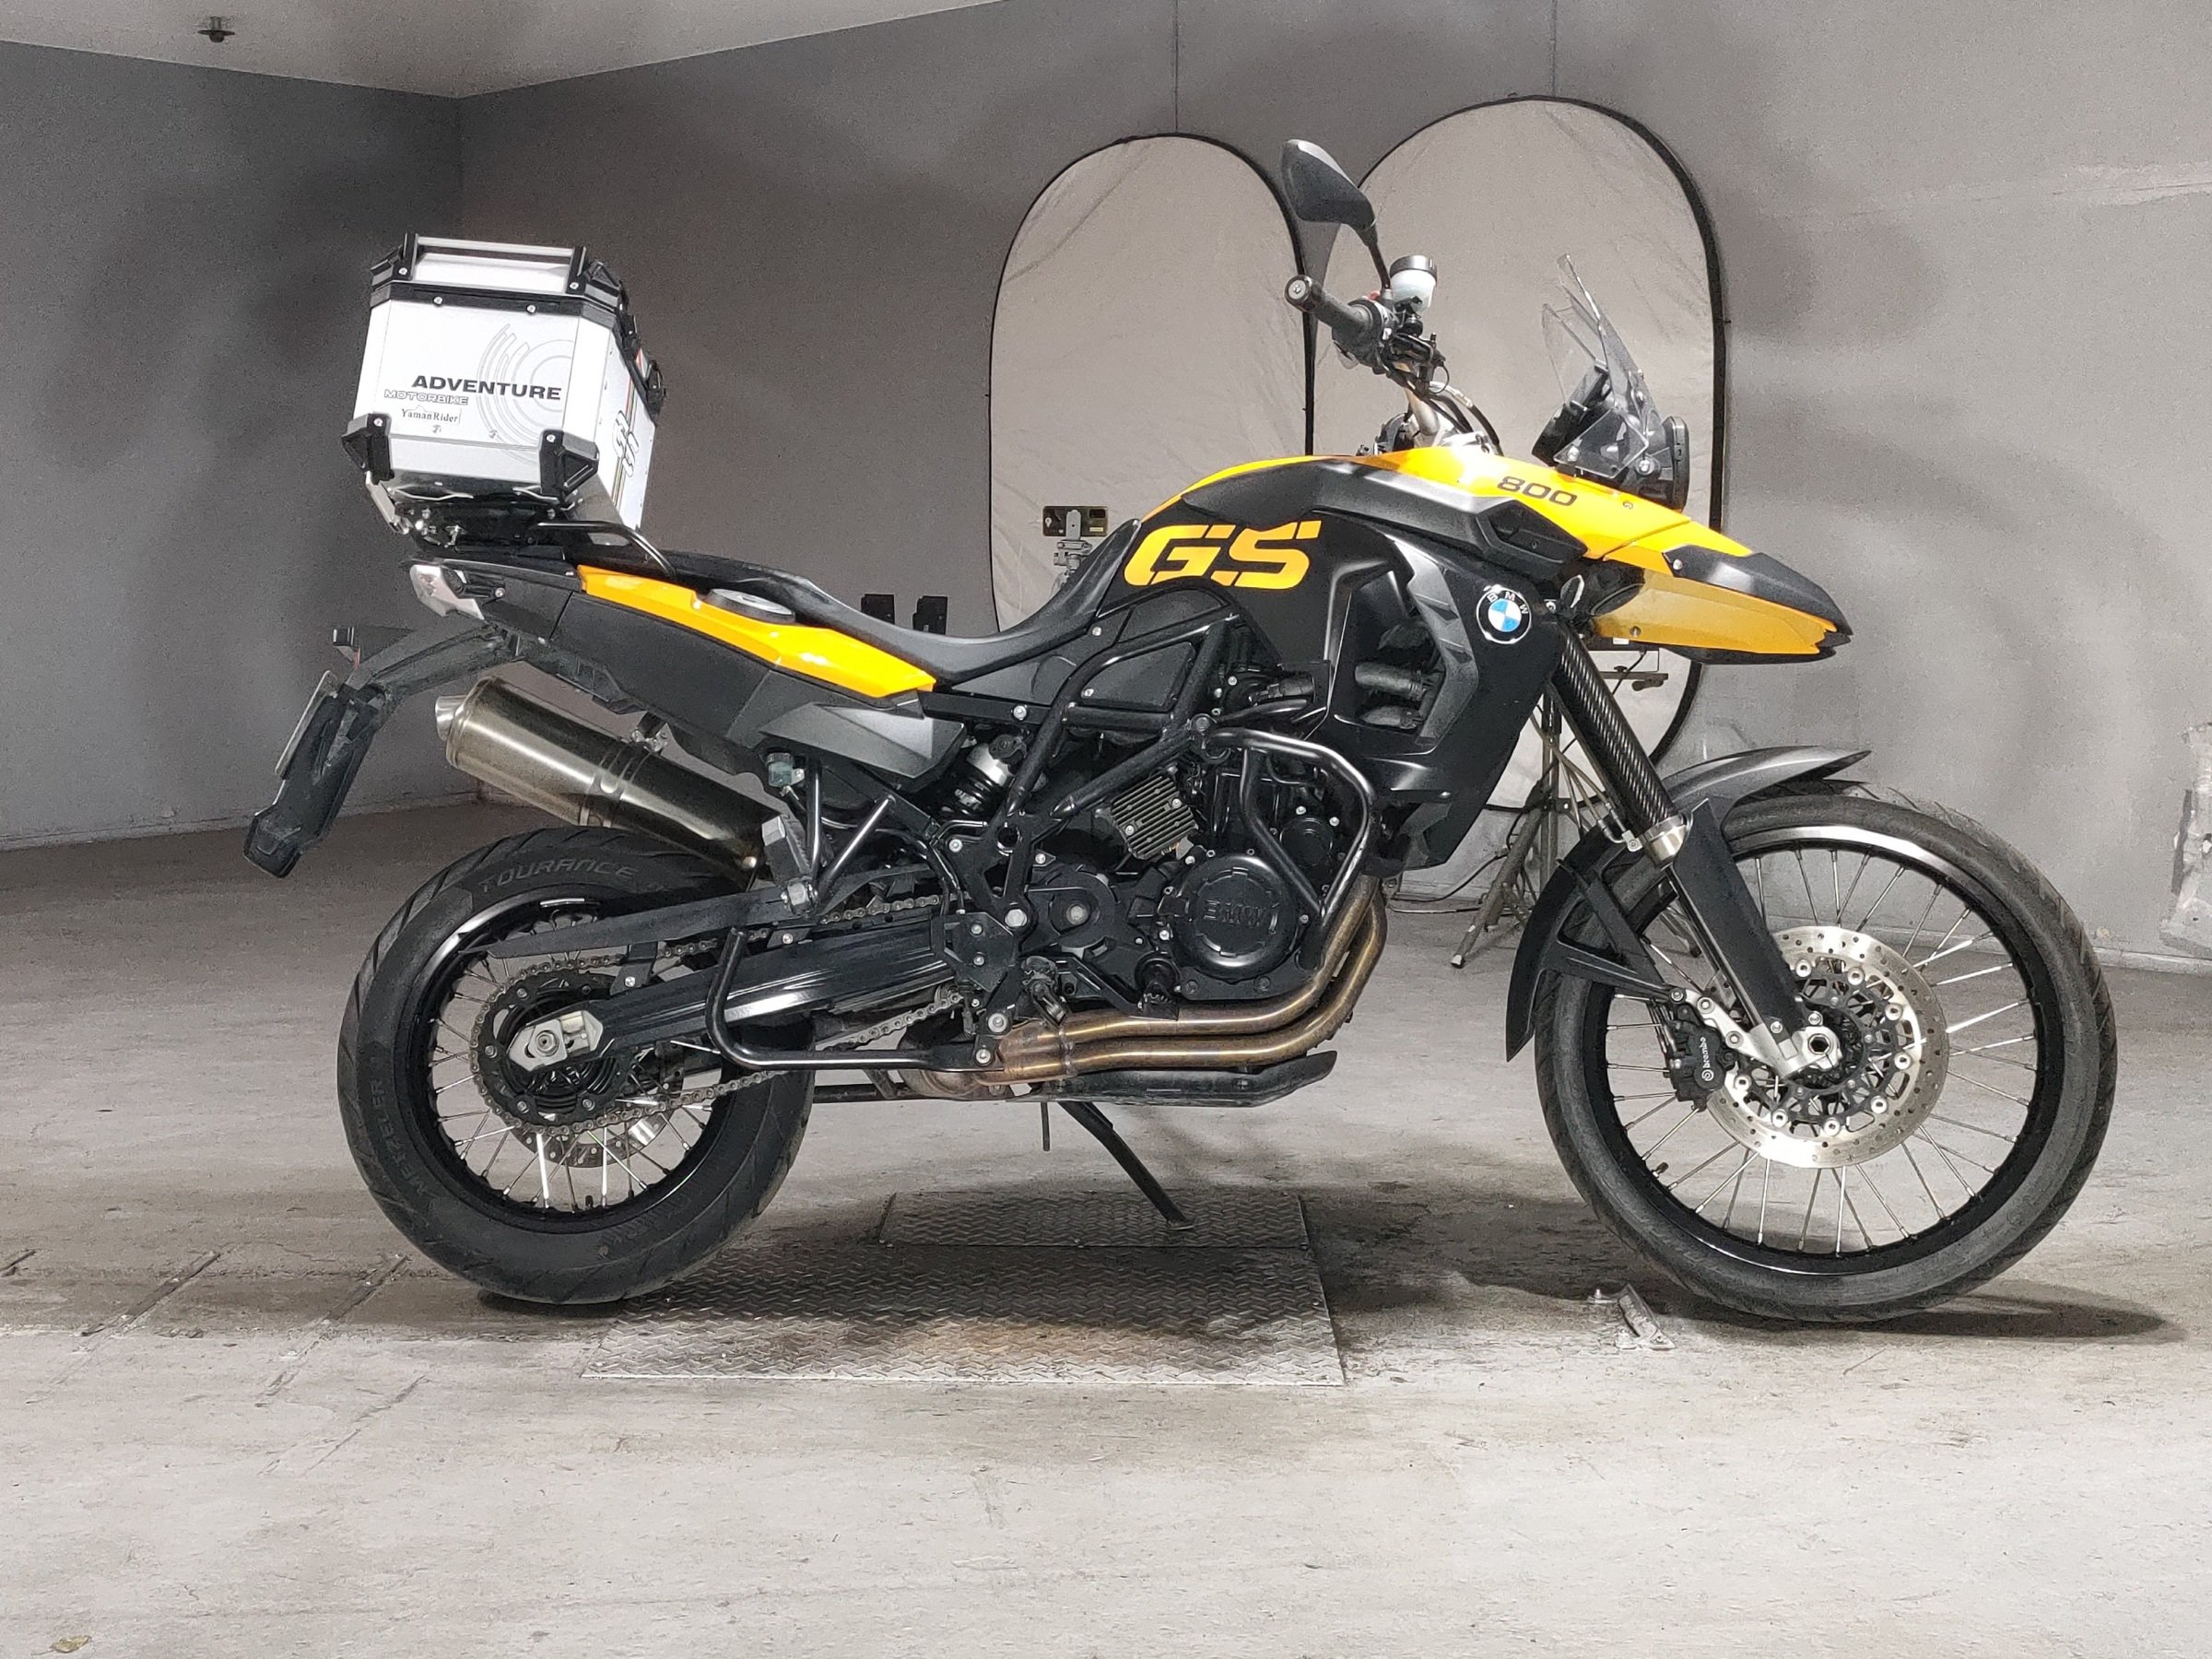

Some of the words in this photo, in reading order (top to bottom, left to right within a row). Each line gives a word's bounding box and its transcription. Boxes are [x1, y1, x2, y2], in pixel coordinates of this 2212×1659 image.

[383, 389, 469, 406] MOTORBIKE
[411, 375, 562, 401] ADVENTURE
[1497, 476, 1578, 506] 800
[1124, 520, 1322, 590] GS
[1486, 591, 1529, 615] BMW
[478, 858, 639, 893] TOURANCE
[1699, 1036, 1711, 1068] brembo
